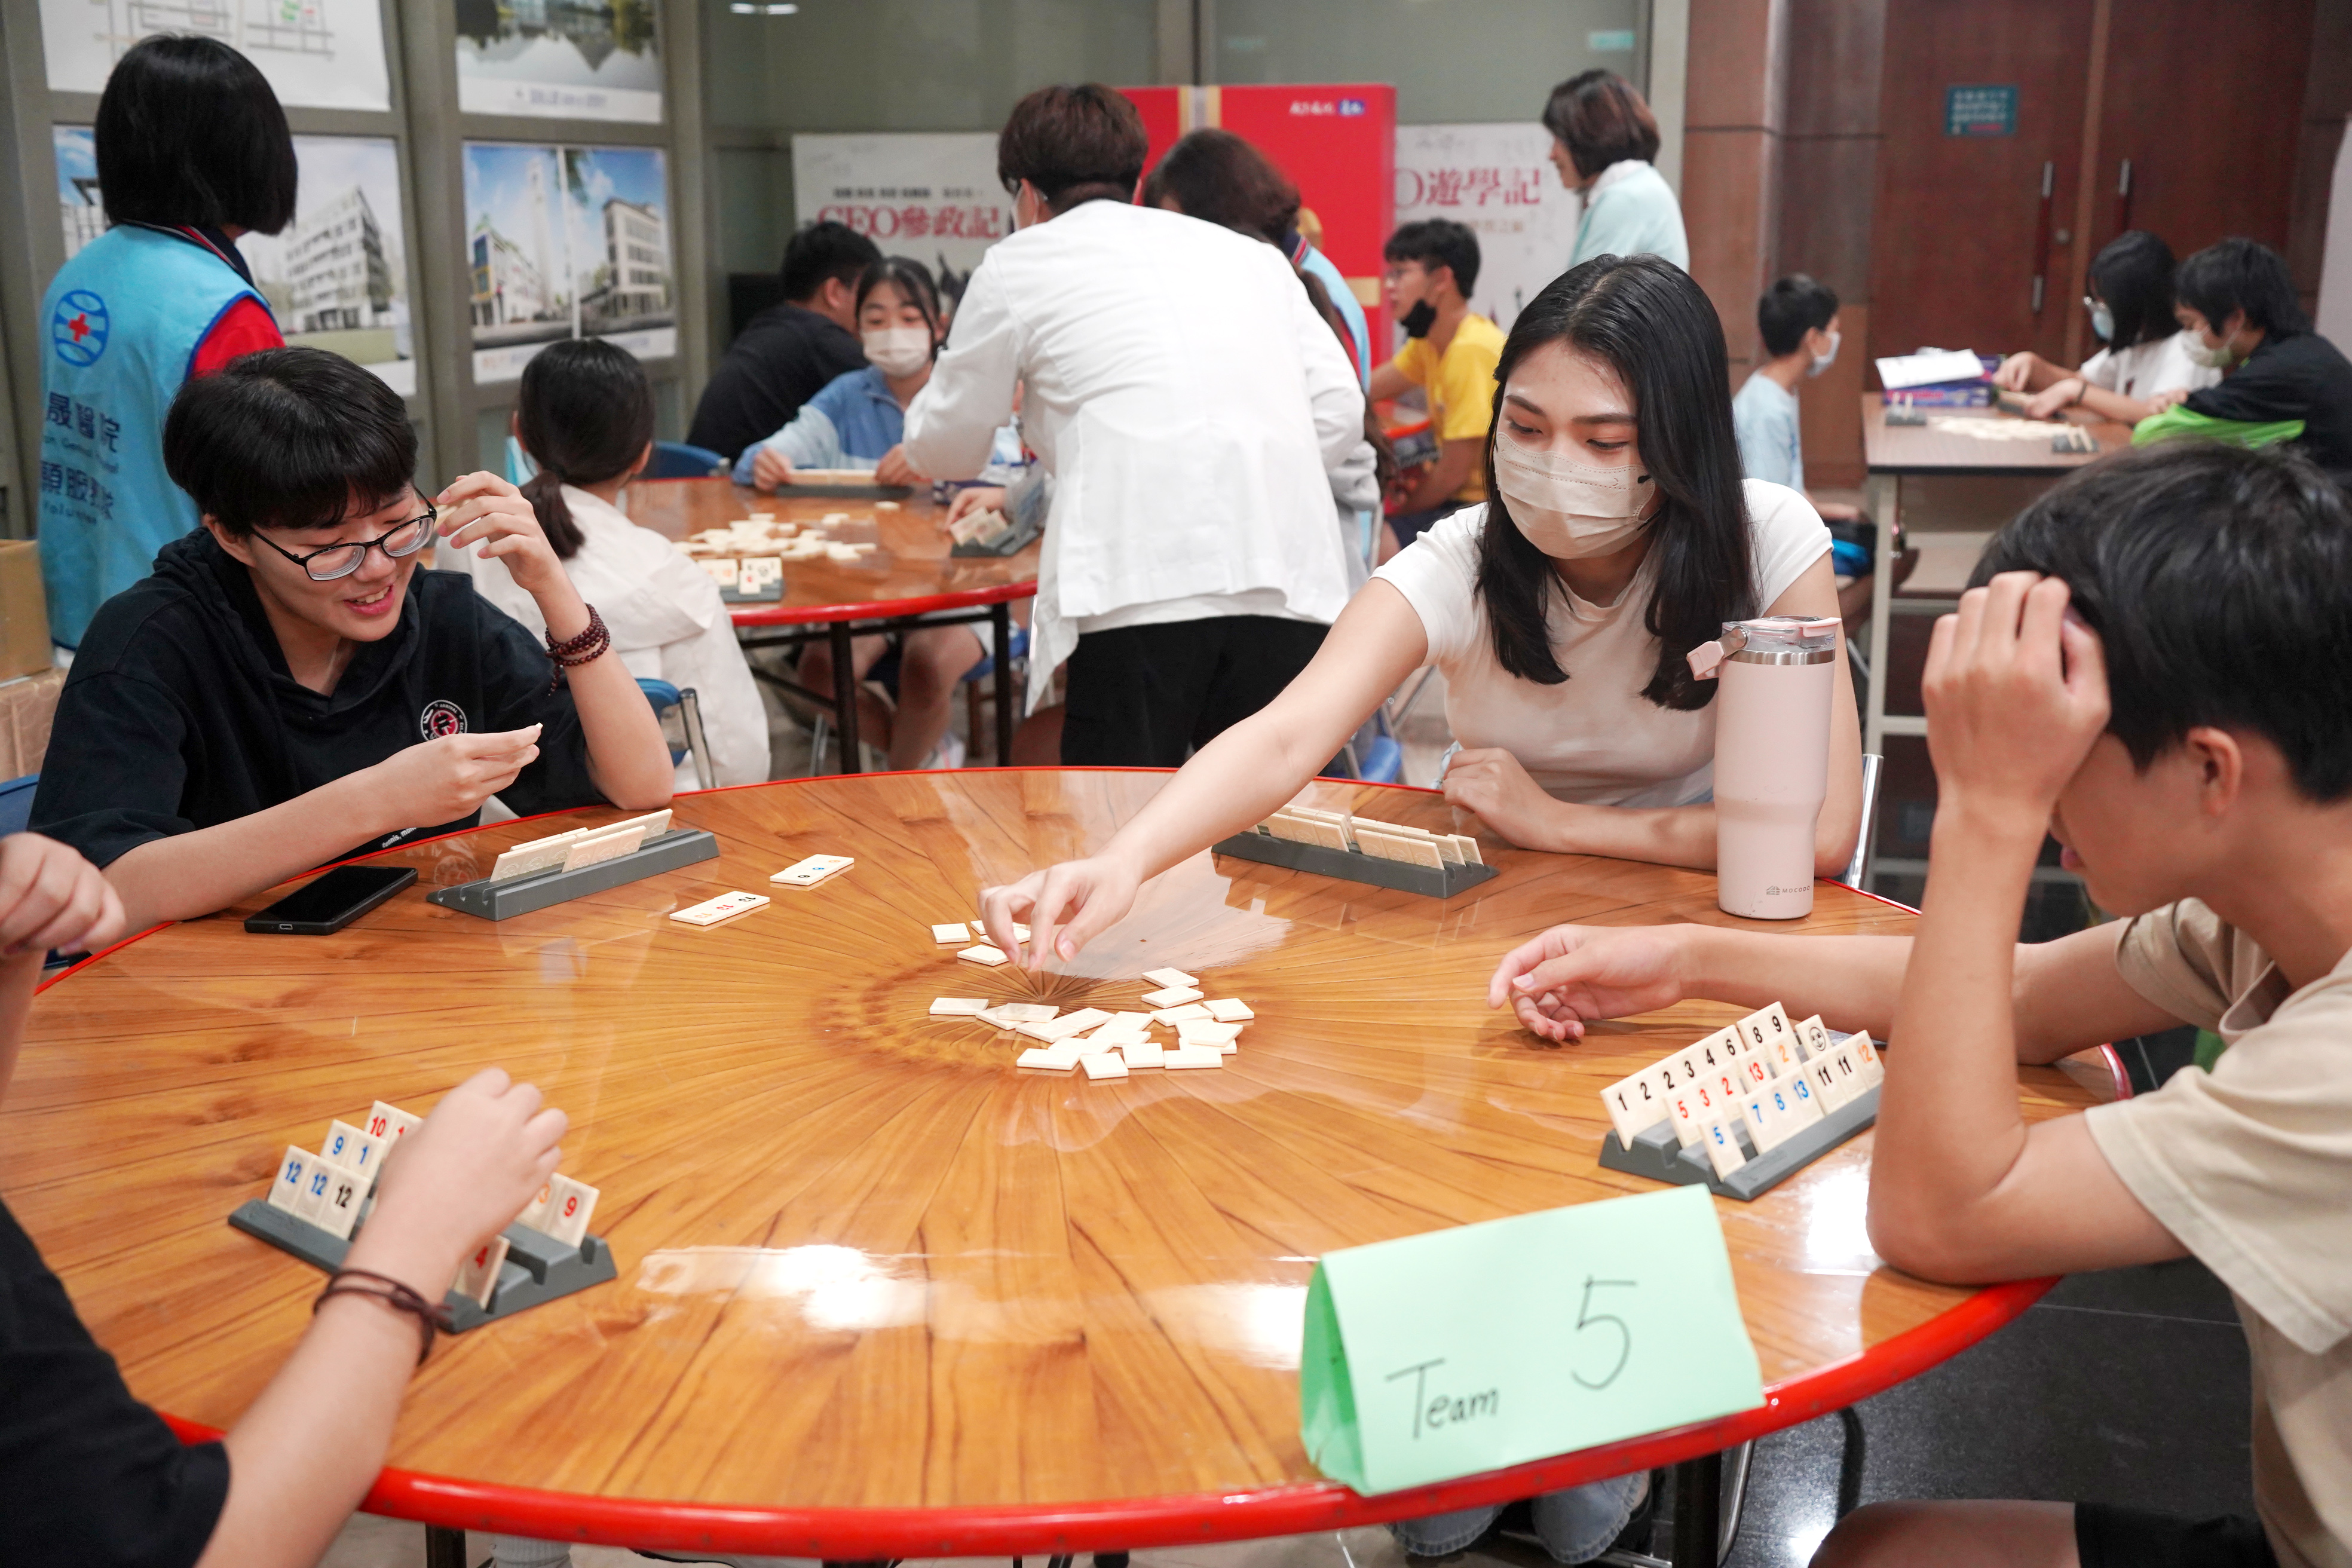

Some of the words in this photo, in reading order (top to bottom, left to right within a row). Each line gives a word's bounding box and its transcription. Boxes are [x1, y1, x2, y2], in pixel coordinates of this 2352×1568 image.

[381, 835, 402, 848] tennis,
[1783, 885, 1811, 893] MOCODO
[1619, 1094, 1627, 1110] 1
[1640, 1082, 1650, 1100] 2
[1664, 1071, 1674, 1089] 2
[1685, 1061, 1694, 1077] 3
[1707, 1049, 1715, 1065] 4
[1726, 1039, 1735, 1055] 6
[1753, 1027, 1762, 1043] 8
[1772, 1016, 1781, 1032] 9
[1678, 1101, 1688, 1118] 5
[1700, 1089, 1710, 1106] 3
[1722, 1077, 1733, 1095] 2
[1750, 1062, 1763, 1082] 13
[1779, 1045, 1789, 1062] 2
[1714, 1127, 1723, 1144] 5
[1752, 1104, 1762, 1123] 7
[1775, 1094, 1784, 1110] 8
[1794, 1080, 1809, 1101] 13
[1818, 1067, 1832, 1085] 11
[1839, 1056, 1851, 1074] 11
[1858, 1044, 1873, 1063] 12
[370, 1117, 386, 1137] 10
[333, 1137, 344, 1154] 9
[360, 1146, 368, 1163] 1
[286, 1162, 301, 1183] 12
[312, 1174, 327, 1195] 12
[336, 1185, 351, 1208] 12
[565, 1197, 577, 1217] 9
[1385, 1357, 1499, 1439] Team
[1571, 1275, 1637, 1391] 5
